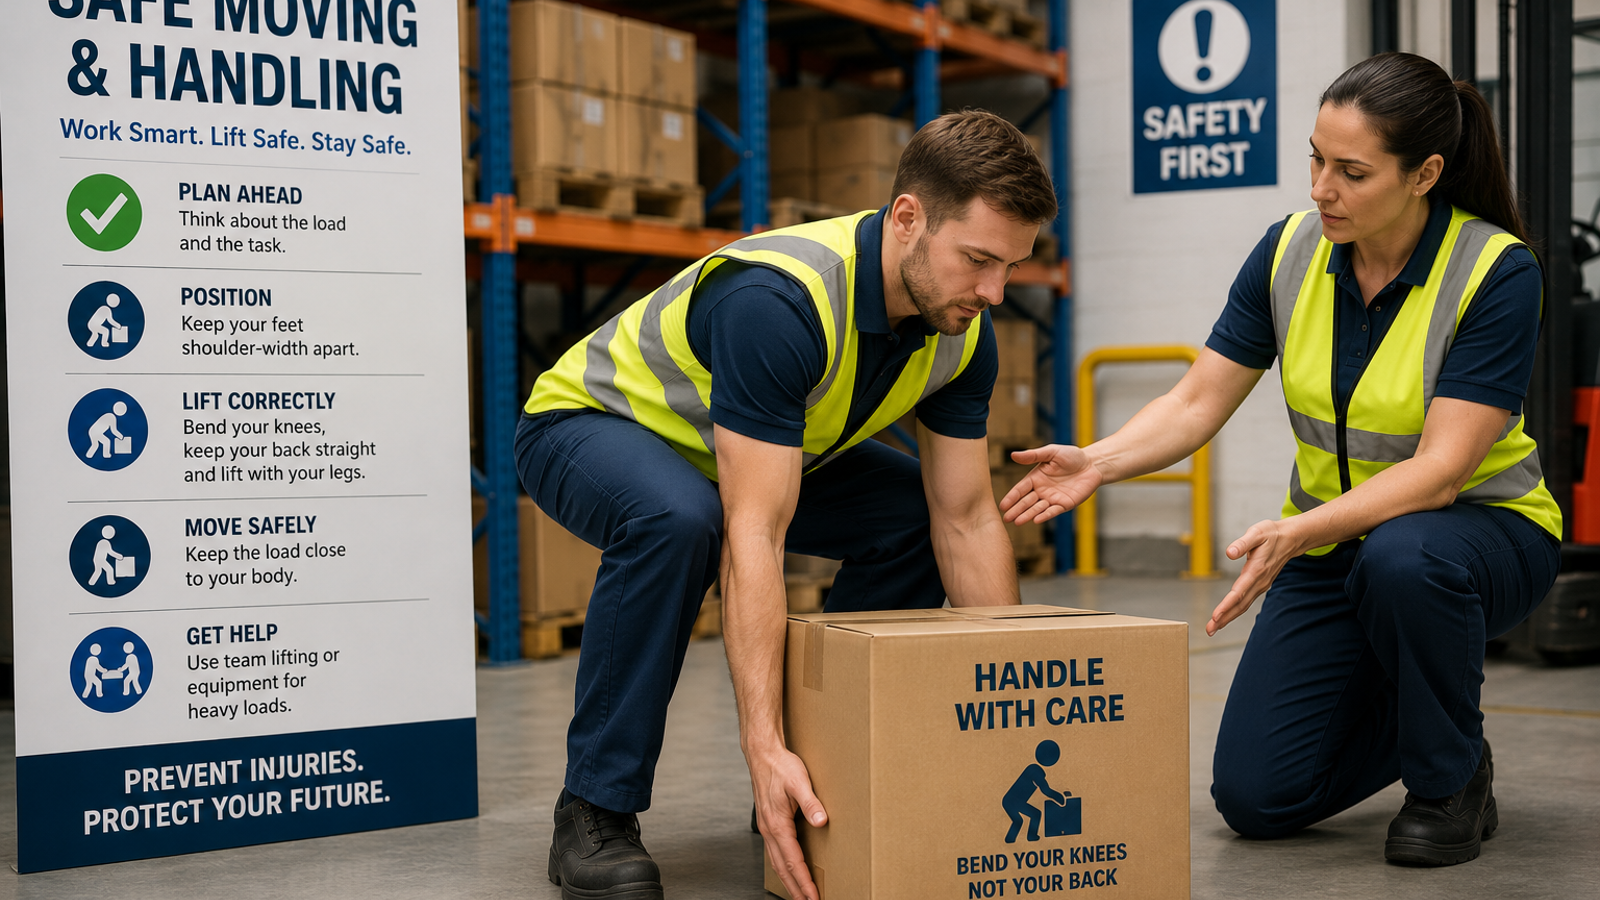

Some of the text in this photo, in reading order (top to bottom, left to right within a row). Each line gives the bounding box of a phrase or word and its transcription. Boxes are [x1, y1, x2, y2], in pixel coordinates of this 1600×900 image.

[68, 39, 402, 114] & HANDLING
[1144, 98, 1266, 140] SAFETY
[60, 118, 410, 157] Work Smart. Lift Safe. Stay Safe.
[1161, 142, 1250, 180] FIRST
[179, 183, 302, 204] PLAN AHEAD
[179, 211, 345, 231] Think about the load
[180, 236, 285, 252] and the task.
[181, 288, 271, 306] POSITION
[182, 316, 303, 335] Keep your feet
[182, 339, 358, 359] shoulder-width apart.
[183, 392, 335, 410] LIFT CORRECTLY
[184, 419, 325, 438] Bend your knees,
[184, 441, 376, 461] keep your back straight
[185, 464, 365, 484] and lift with your legs.
[186, 516, 316, 536] MOVE SAFELY
[186, 542, 345, 564] Keep the load close
[186, 567, 297, 589] to your body.
[187, 624, 277, 645] GET HELP
[188, 649, 339, 670] Use team lifting or
[188, 673, 306, 697] equipment for
[975, 658, 1104, 692] HANDLE
[189, 697, 291, 720] heavy loads.
[955, 694, 1124, 731] WITH CARE
[125, 749, 363, 793] PREVENT INJURIES.
[85, 780, 390, 835] PROTECT YOUR FUTURE.
[957, 843, 1127, 875] BEND YOUR KNEES
[969, 868, 1117, 899] NOT YOUR BACK
